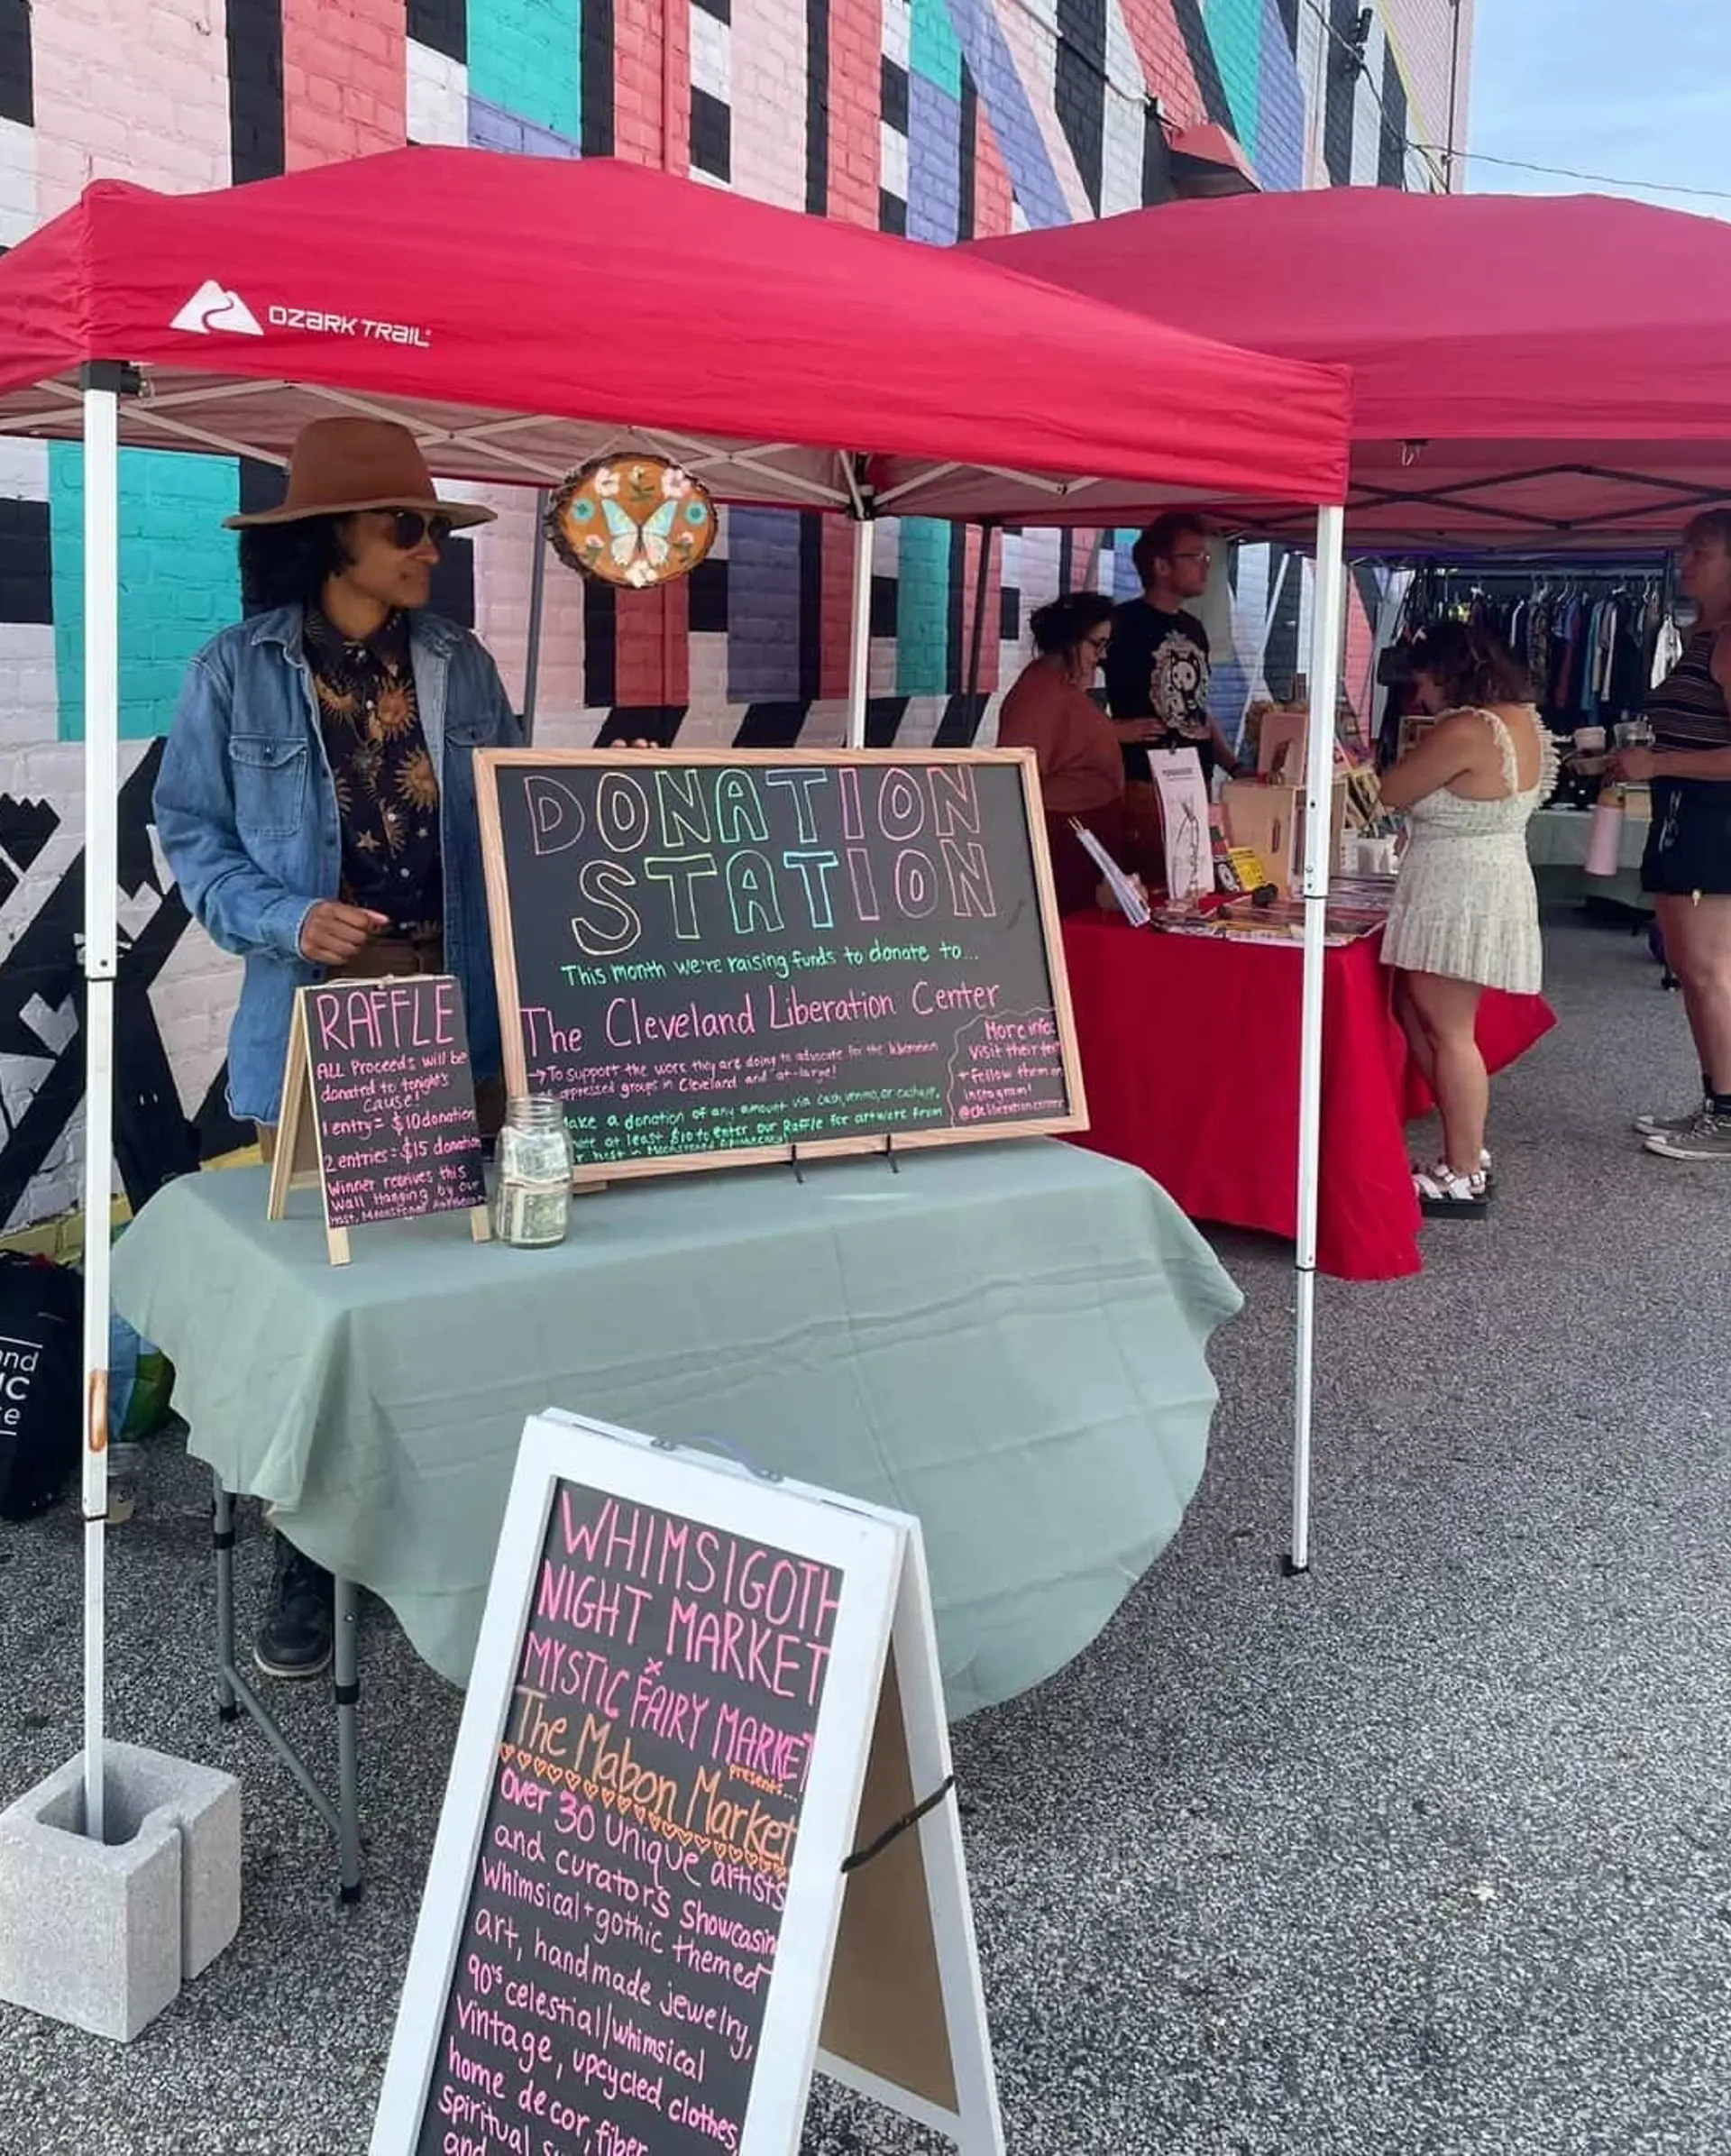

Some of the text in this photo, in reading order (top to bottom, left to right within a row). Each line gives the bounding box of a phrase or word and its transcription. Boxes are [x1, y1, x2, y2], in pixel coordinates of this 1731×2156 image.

[524, 766, 982, 855] DONATION
[571, 839, 997, 956] STATION
[560, 964, 608, 986] This
[612, 961, 667, 984] month
[673, 957, 723, 976] we're
[728, 951, 790, 979] raising
[792, 946, 838, 970] funds
[844, 946, 864, 965] to
[868, 938, 930, 962] donate
[316, 984, 454, 1051] RAFFLE
[519, 980, 1000, 1057] The Cleveland Liberation Center
[985, 1020, 1027, 1041] More
[422, 1050, 447, 1068] will
[450, 1050, 468, 1065] be
[546, 1065, 563, 1081] To
[624, 1062, 649, 1078] the
[719, 1058, 742, 1071] are
[679, 1075, 737, 1093] Cleveland
[362, 1090, 420, 1113] cause!
[380, 1080, 397, 1095] to
[391, 1111, 421, 1137] $10
[422, 1107, 477, 1128] donation
[607, 1115, 620, 1127] a
[625, 1112, 684, 1131] donation
[691, 1106, 707, 1120] of
[710, 1106, 735, 1121] any
[740, 1102, 788, 1115] amount
[626, 1132, 664, 1147] least
[324, 1155, 339, 1173] 2
[338, 1148, 389, 1170] entries
[398, 1135, 429, 1165] $15
[433, 1135, 482, 1156] donation
[327, 1178, 376, 1197] Winner
[438, 1164, 467, 1181] this
[436, 1184, 454, 1199] by
[562, 1489, 841, 1638] WHIMSIGOTH
[537, 1558, 830, 1707] NIGHT MARKET
[522, 1629, 813, 1793] MYSTIC FAIRY MARKET
[516, 1684, 798, 1861] The Mabon Market
[494, 1823, 546, 1865] and
[554, 1849, 672, 1918] curators
[554, 1788, 596, 1842] 30
[710, 1860, 787, 1912] artists
[468, 1952, 503, 1995] 90's
[594, 1907, 664, 1955] gothic
[672, 1934, 774, 1995] themed
[659, 1979, 754, 2060] jewelry,
[450, 2034, 506, 2099] home
[595, 2119, 649, 2156] fiber
[572, 2047, 664, 2112] upcycled
